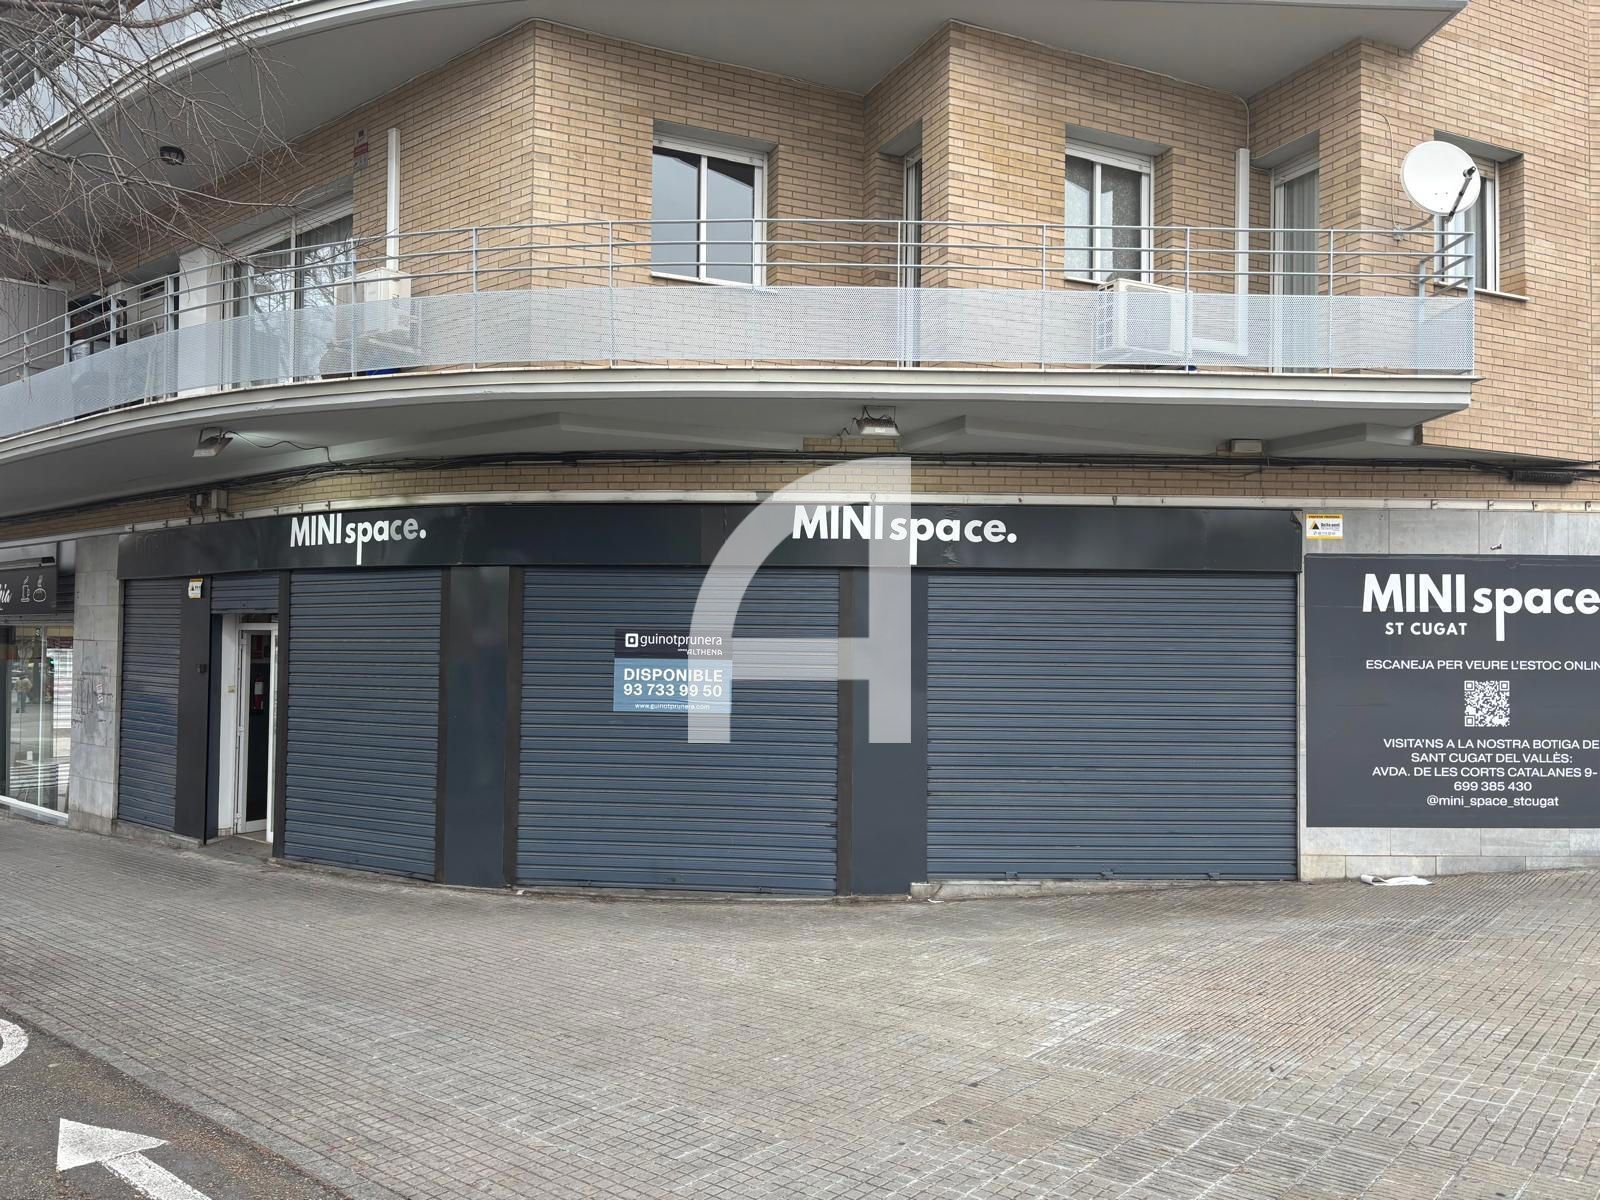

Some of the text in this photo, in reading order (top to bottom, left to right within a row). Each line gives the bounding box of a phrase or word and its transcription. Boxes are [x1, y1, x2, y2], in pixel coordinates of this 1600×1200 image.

[290, 513, 427, 565] MINI space.
[792, 505, 1018, 565] MINI space.
[1363, 574, 1466, 612] MINI
[1385, 622, 1467, 635] ST CUGAT
[640, 633, 723, 647] guinotprunera
[1366, 659, 1435, 670] ESCANEJA
[1437, 659, 1463, 670] PER
[1464, 660, 1509, 670] VEURE
[624, 668, 723, 682] DISPONIBLE
[624, 684, 723, 697] 93 733 99 50
[634, 703, 711, 711] www.guinotprunera.com
[1383, 738, 1600, 750] VISITA'NS A LA NOSTRA BOTIGA DE
[1410, 752, 1447, 763] SANT
[1448, 752, 1494, 763] CUGAT
[1495, 753, 1521, 763] DEL
[1371, 766, 1411, 777] AVDA.
[1413, 766, 1432, 777] DE
[1434, 766, 1458, 777] LES
[1460, 766, 1506, 778] CORTS
[1507, 767, 1582, 778] CATALANES
[1453, 781, 1533, 792] 699 385 430
[1426, 794, 1559, 809] @mini_space_stcugat
